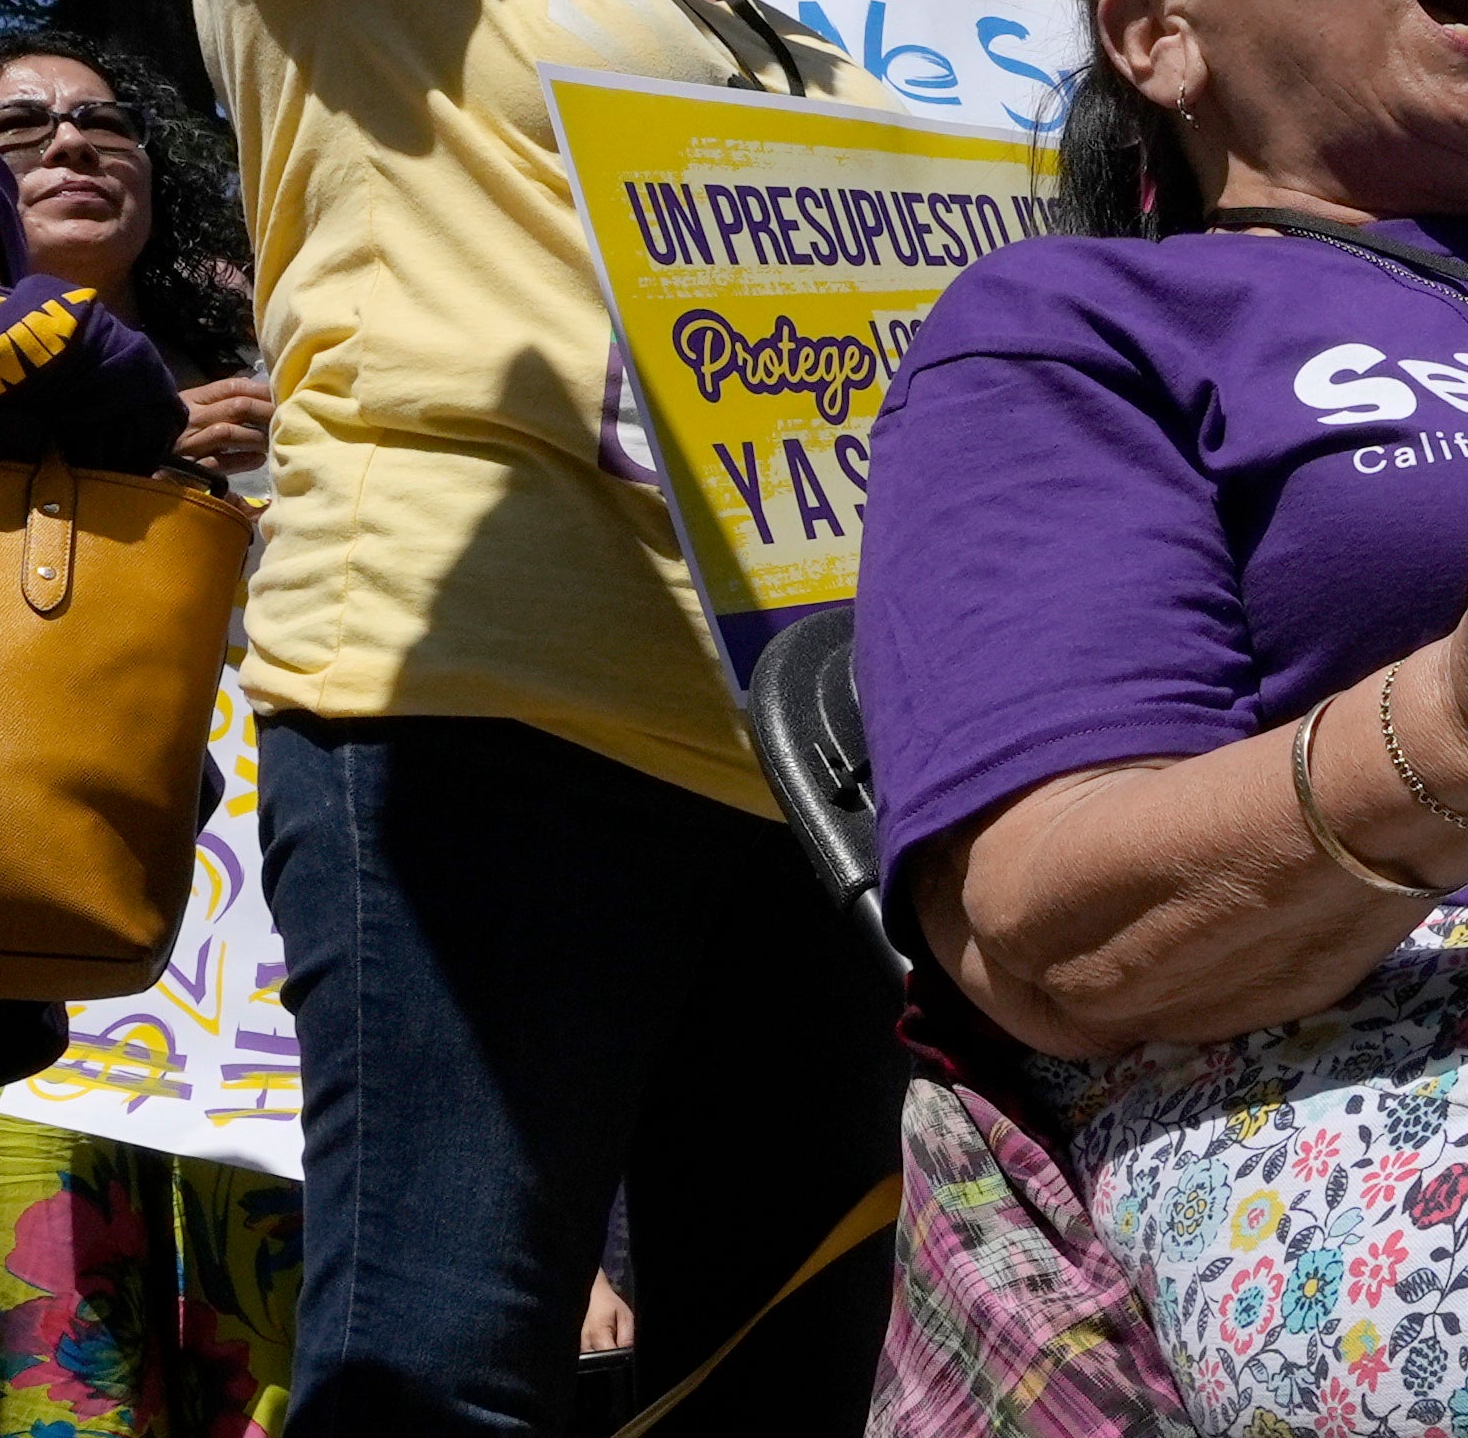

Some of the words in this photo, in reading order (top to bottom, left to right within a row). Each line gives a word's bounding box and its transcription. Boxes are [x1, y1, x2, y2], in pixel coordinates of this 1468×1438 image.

[624, 181, 712, 266] UN
[707, 185, 1012, 267] PRESUPUESTO
[673, 310, 876, 422] Protege
[714, 442, 774, 545] Y
[782, 437, 845, 540] A
